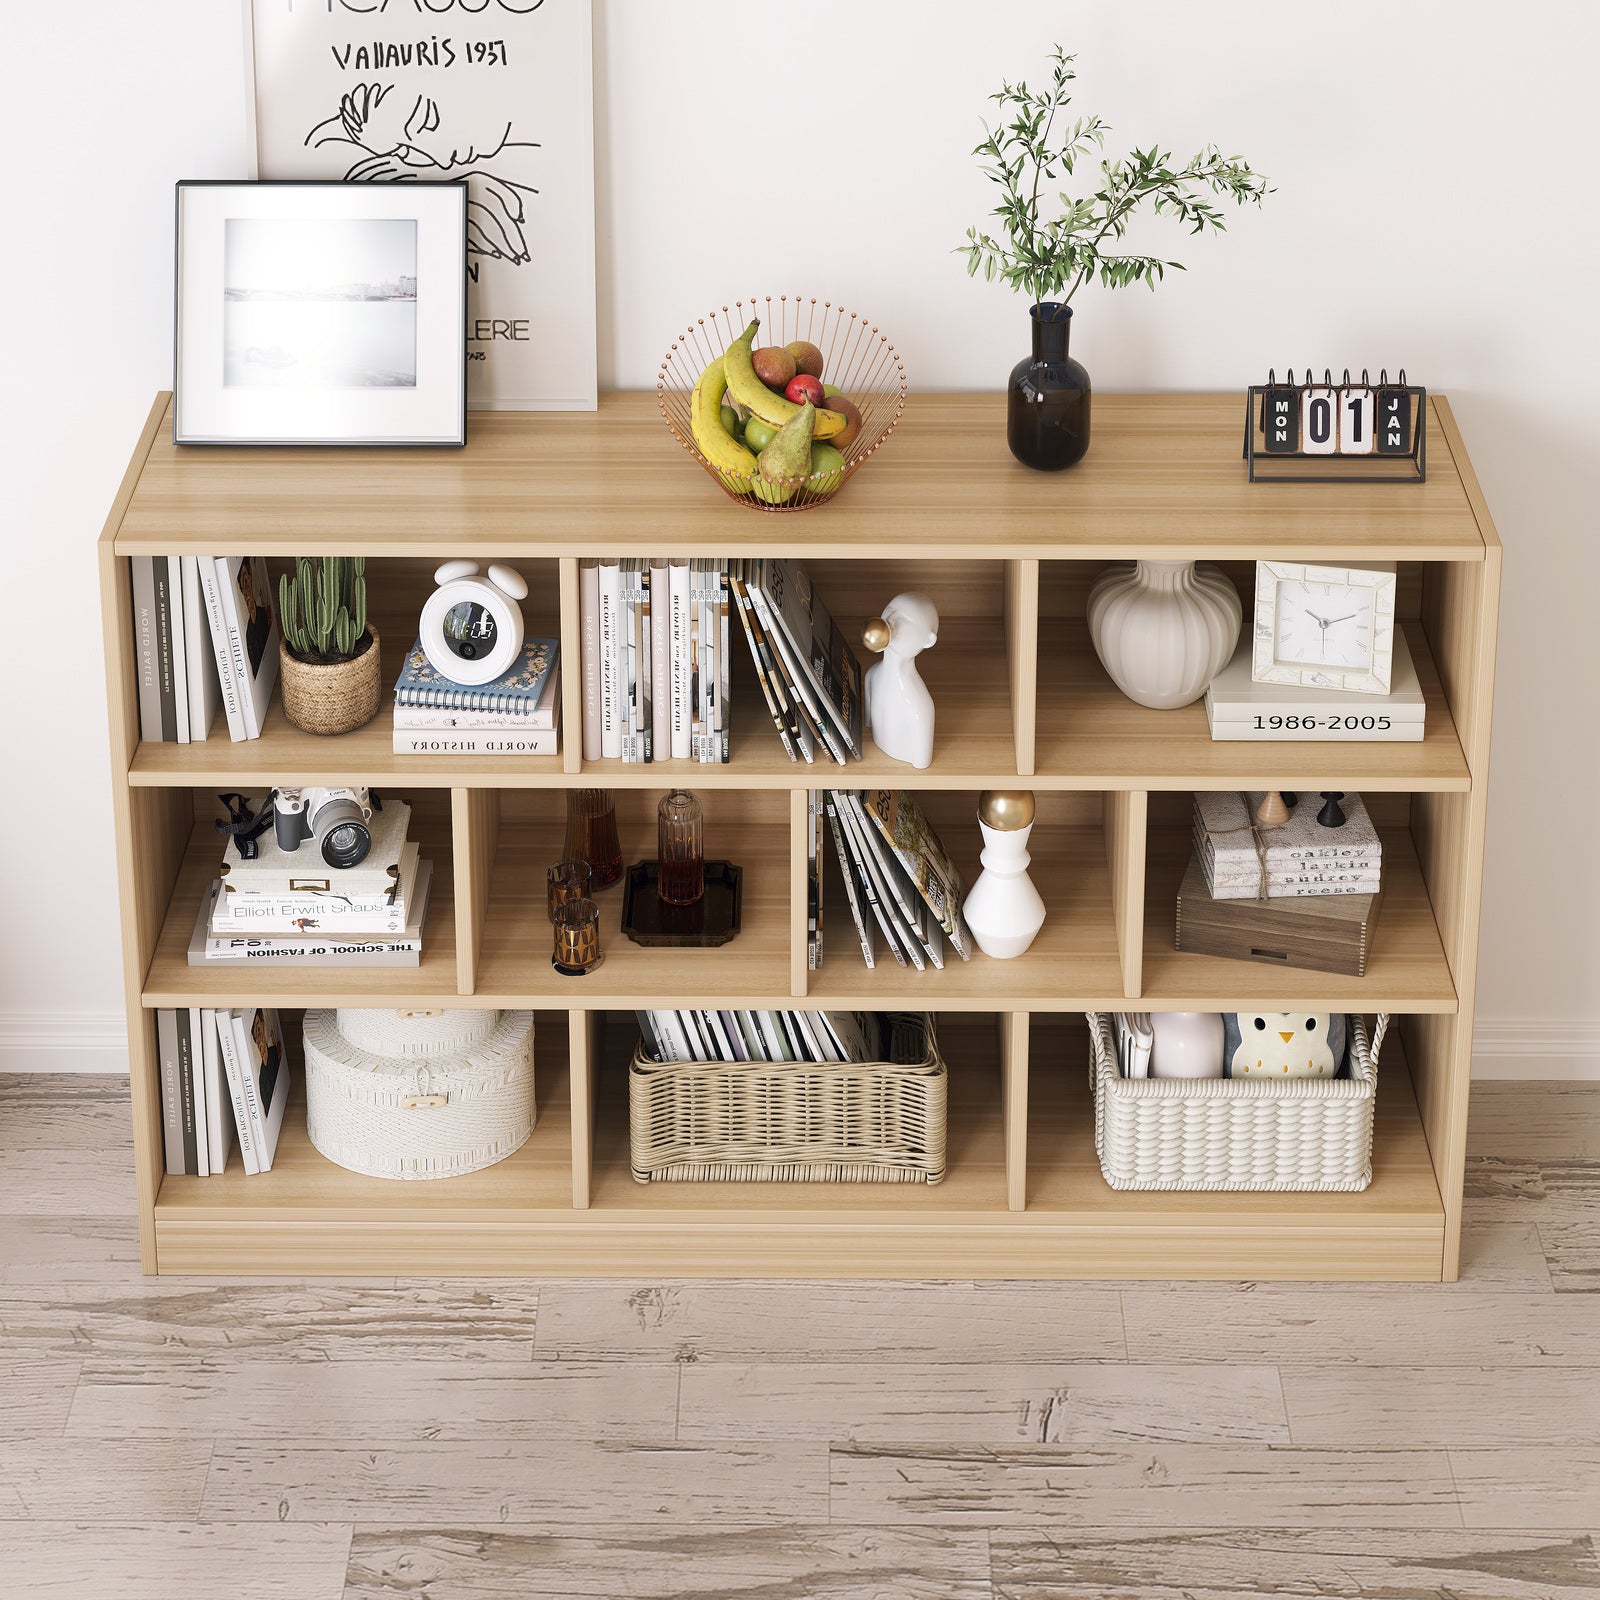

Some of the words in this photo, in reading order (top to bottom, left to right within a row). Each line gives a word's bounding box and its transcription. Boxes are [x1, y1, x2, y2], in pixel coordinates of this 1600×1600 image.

[1275, 401, 1289, 442] MON
[1310, 397, 1364, 444] 01
[1387, 398, 1401, 446] JAN
[1252, 714, 1393, 731] 1986-2005
[1290, 847, 1367, 859] oakley
[1300, 860, 1370, 870] larkin
[1285, 873, 1364, 883] audrey
[1296, 886, 1356, 895] reese
[234, 907, 275, 918] Elliott
[281, 905, 325, 916] Erwitt
[247, 949, 305, 957] FASHION
[309, 947, 326, 955] OF
[330, 945, 384, 954] SCHOOL
[387, 944, 414, 952] THE
